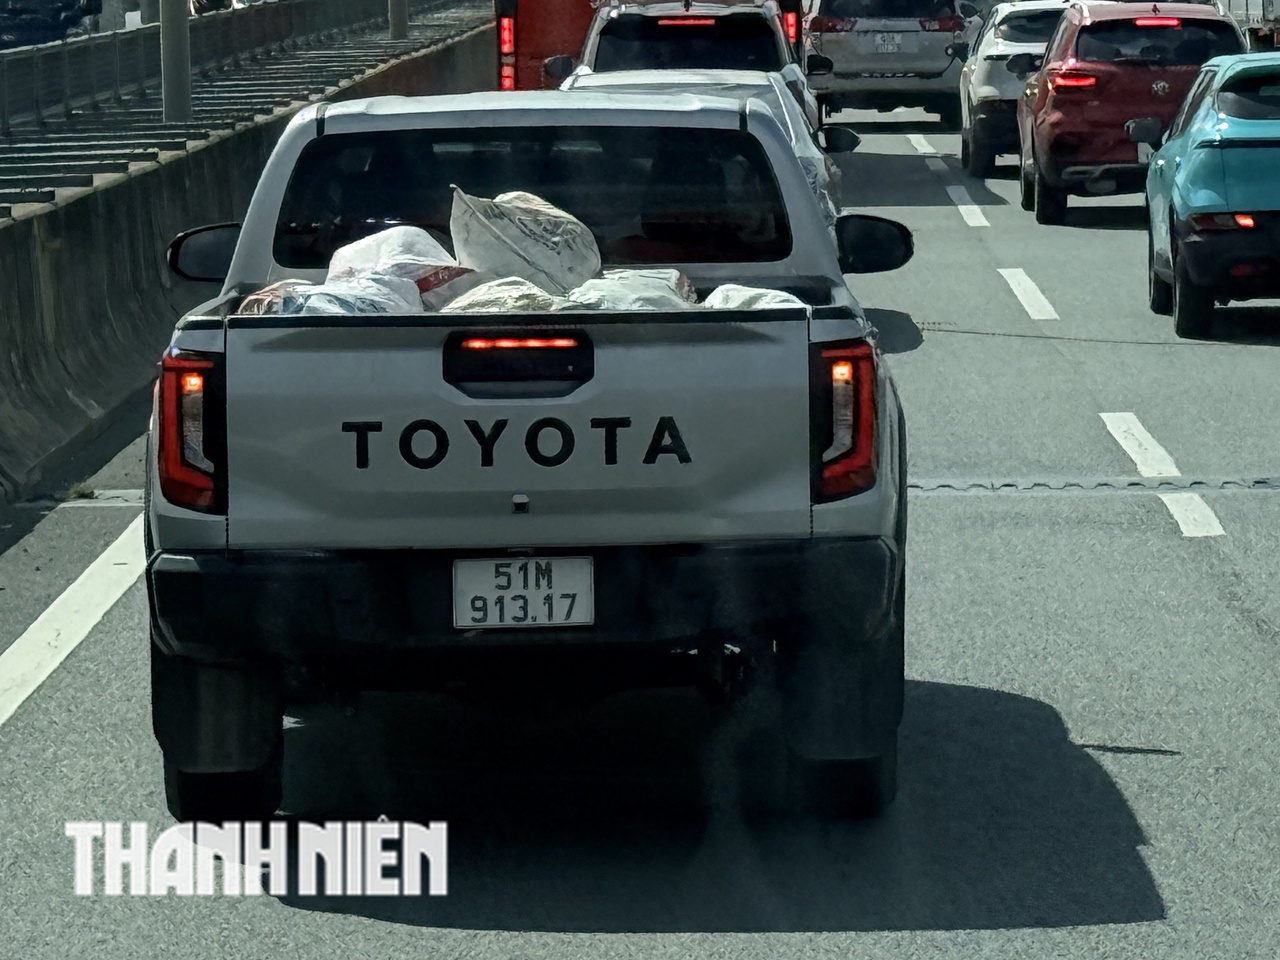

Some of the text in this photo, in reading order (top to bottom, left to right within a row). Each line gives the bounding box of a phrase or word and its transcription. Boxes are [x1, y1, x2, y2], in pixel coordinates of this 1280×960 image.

[342, 416, 692, 469] TOYOTA
[494, 561, 553, 590] 51M
[470, 593, 577, 623] 913.17
